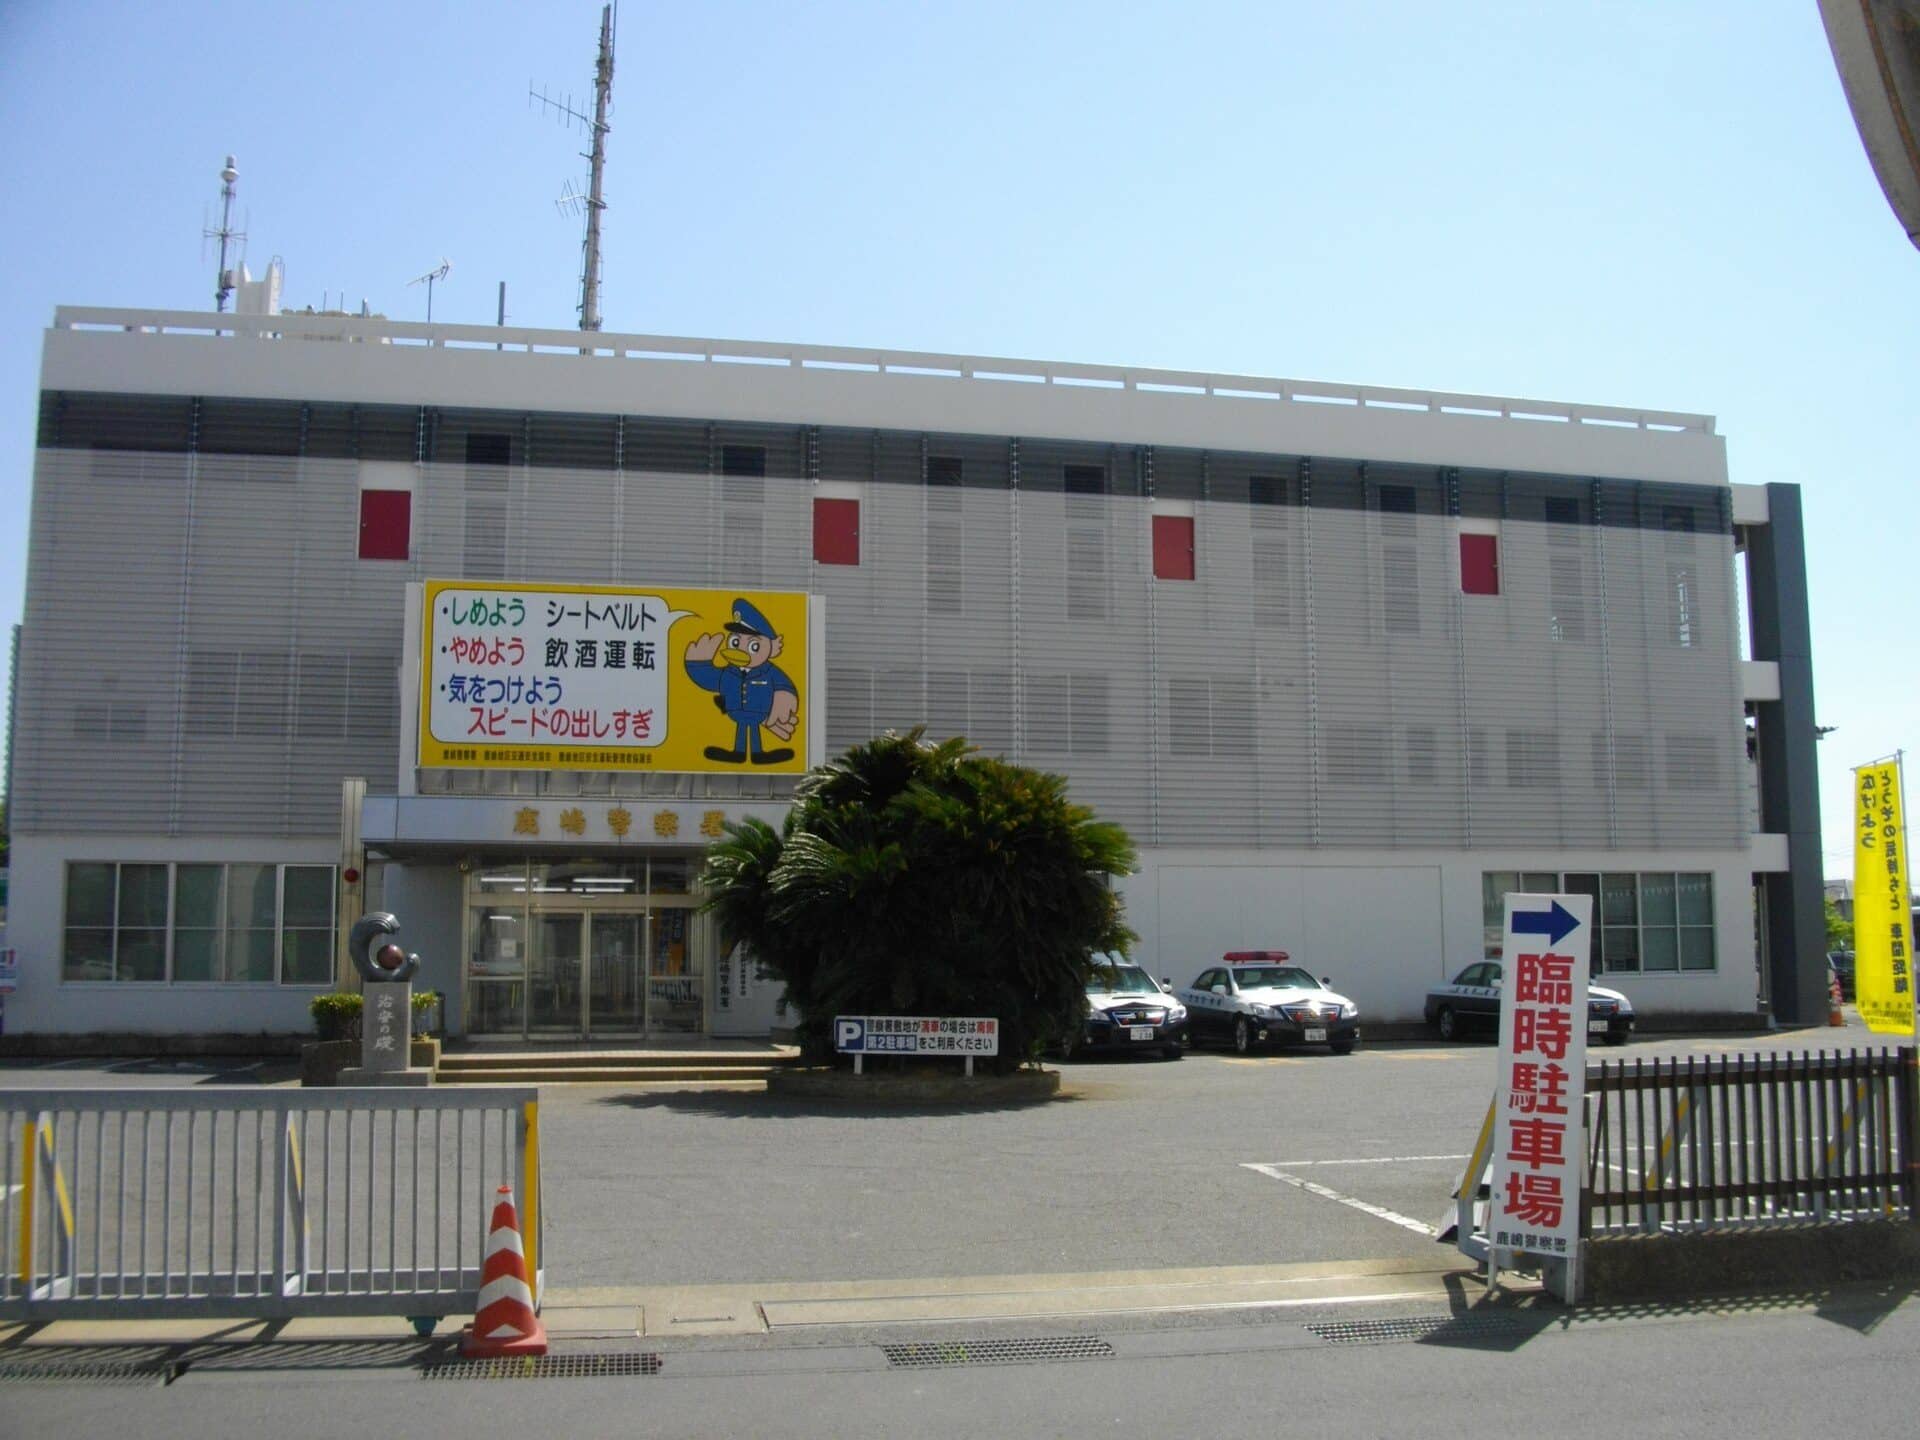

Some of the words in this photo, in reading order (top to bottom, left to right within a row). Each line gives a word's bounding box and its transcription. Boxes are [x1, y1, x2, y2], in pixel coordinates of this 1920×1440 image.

[450, 597, 526, 628] しめよう
[546, 600, 657, 632] シートベルト
[449, 636, 526, 667] やめよう
[544, 638, 656, 671] 飲酒運転
[448, 673, 563, 706] 気をつけよう
[467, 706, 653, 739] スピードの出しすぎ
[918, 1036, 993, 1051] をご利用ください
[1503, 952, 1575, 1229] 臨時駐車場
[1496, 1230, 1568, 1253] 鹿嶋警察署
